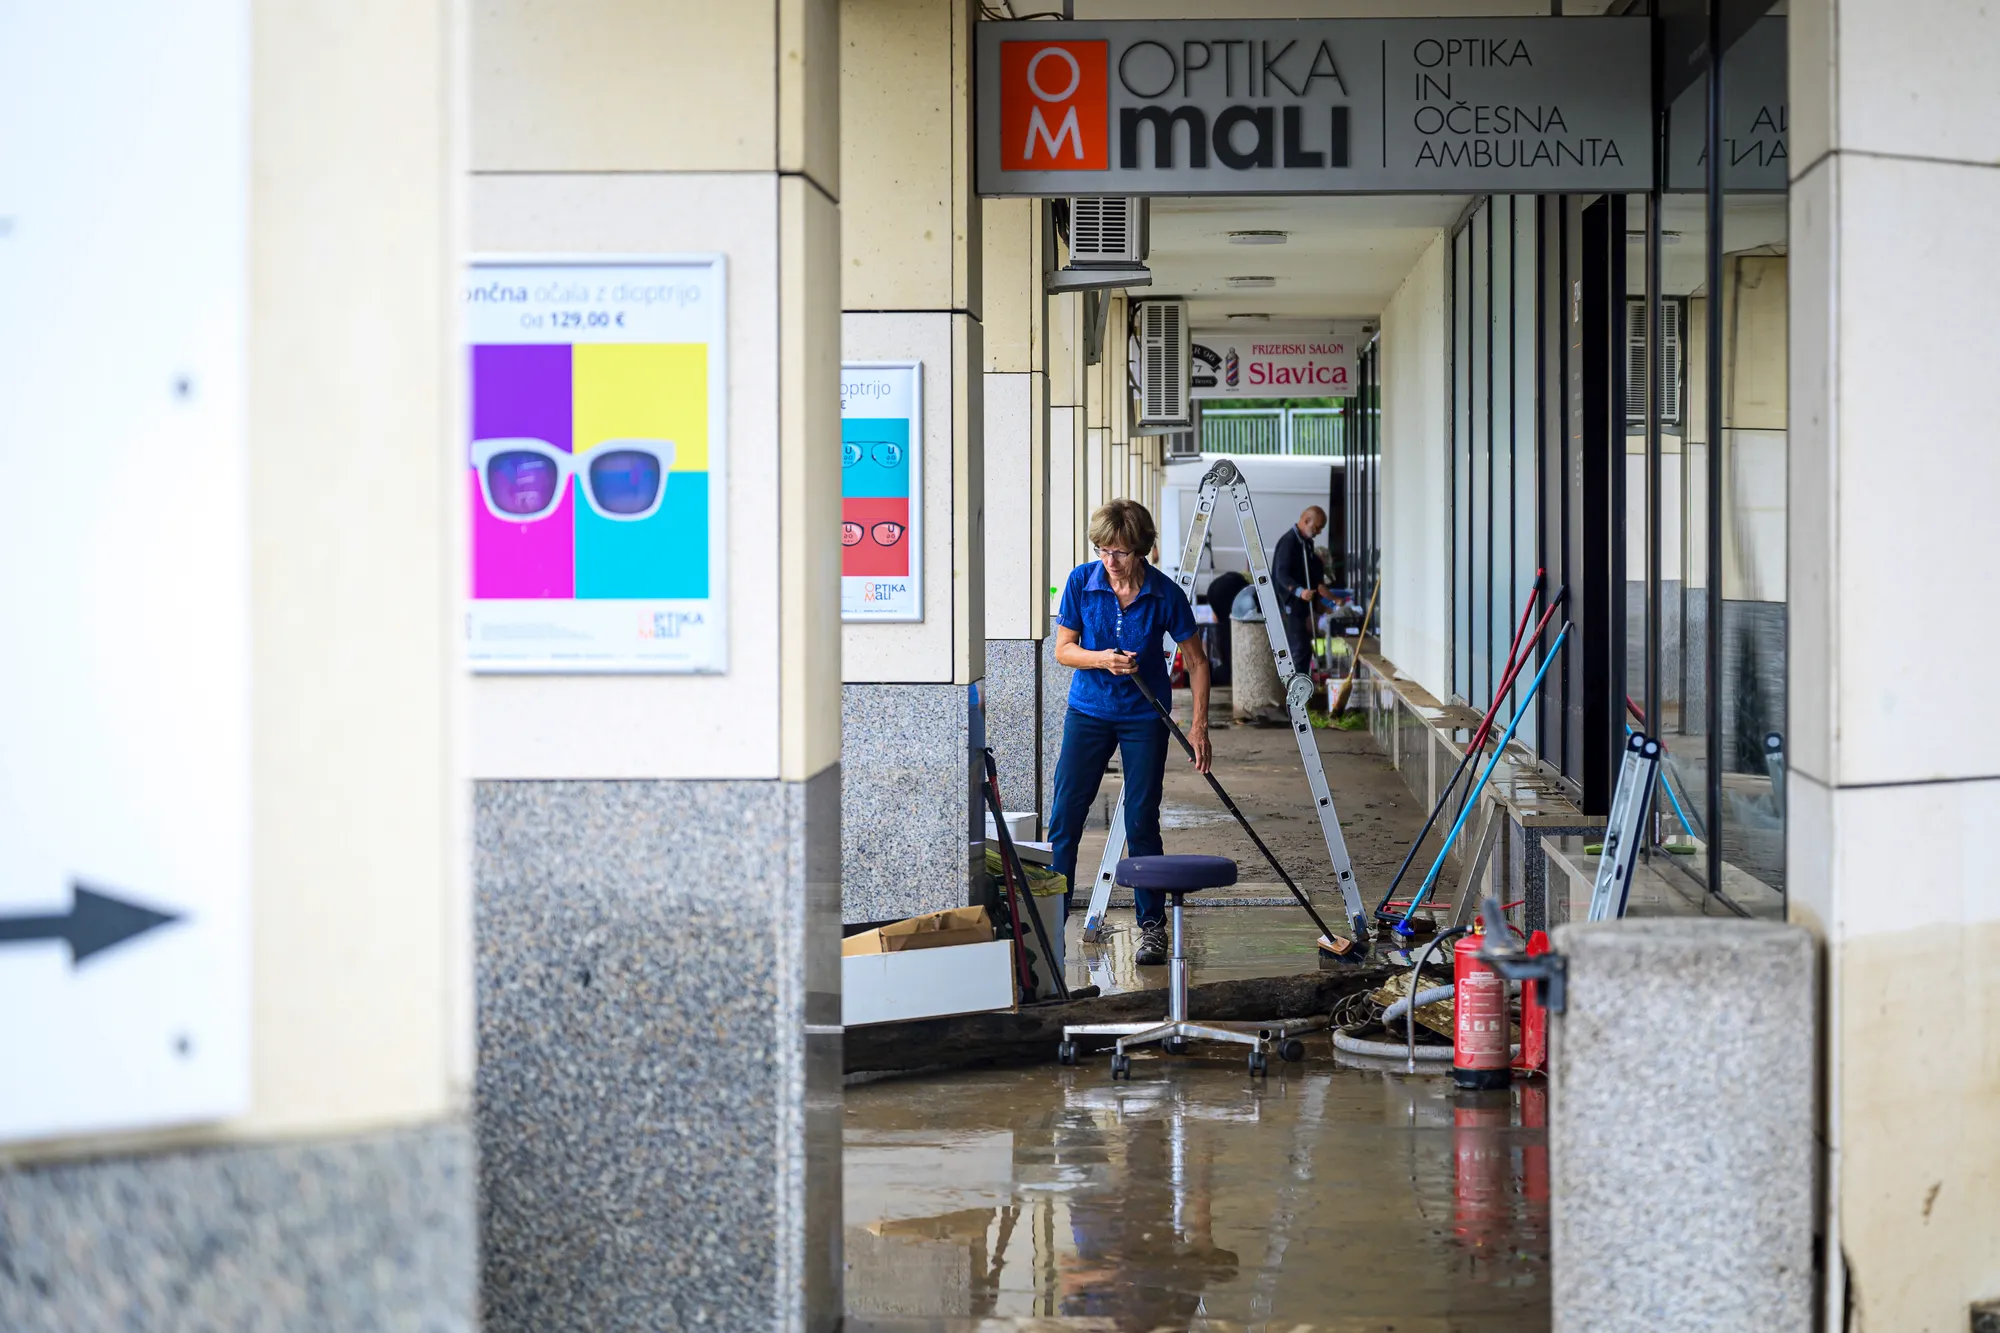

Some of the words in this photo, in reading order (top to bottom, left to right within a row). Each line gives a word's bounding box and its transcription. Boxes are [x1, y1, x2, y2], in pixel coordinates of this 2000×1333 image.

[1414, 39, 1532, 67] OPTIKA
[1119, 40, 1347, 98] OPTIKA
[1416, 73, 1451, 100] IN
[1414, 101, 1567, 134] OČESNA
[1415, 139, 1624, 167] AMBULANTA
[595, 287, 605, 302] z
[612, 283, 700, 308] dioptrijo
[550, 311, 610, 329] 129,00
[615, 311, 626, 327] €
[1252, 344, 1306, 355] FRIZERSKI
[1309, 343, 1344, 354] SALON
[1248, 361, 1348, 384] Slavica
[865, 582, 907, 593] OPTIKA
